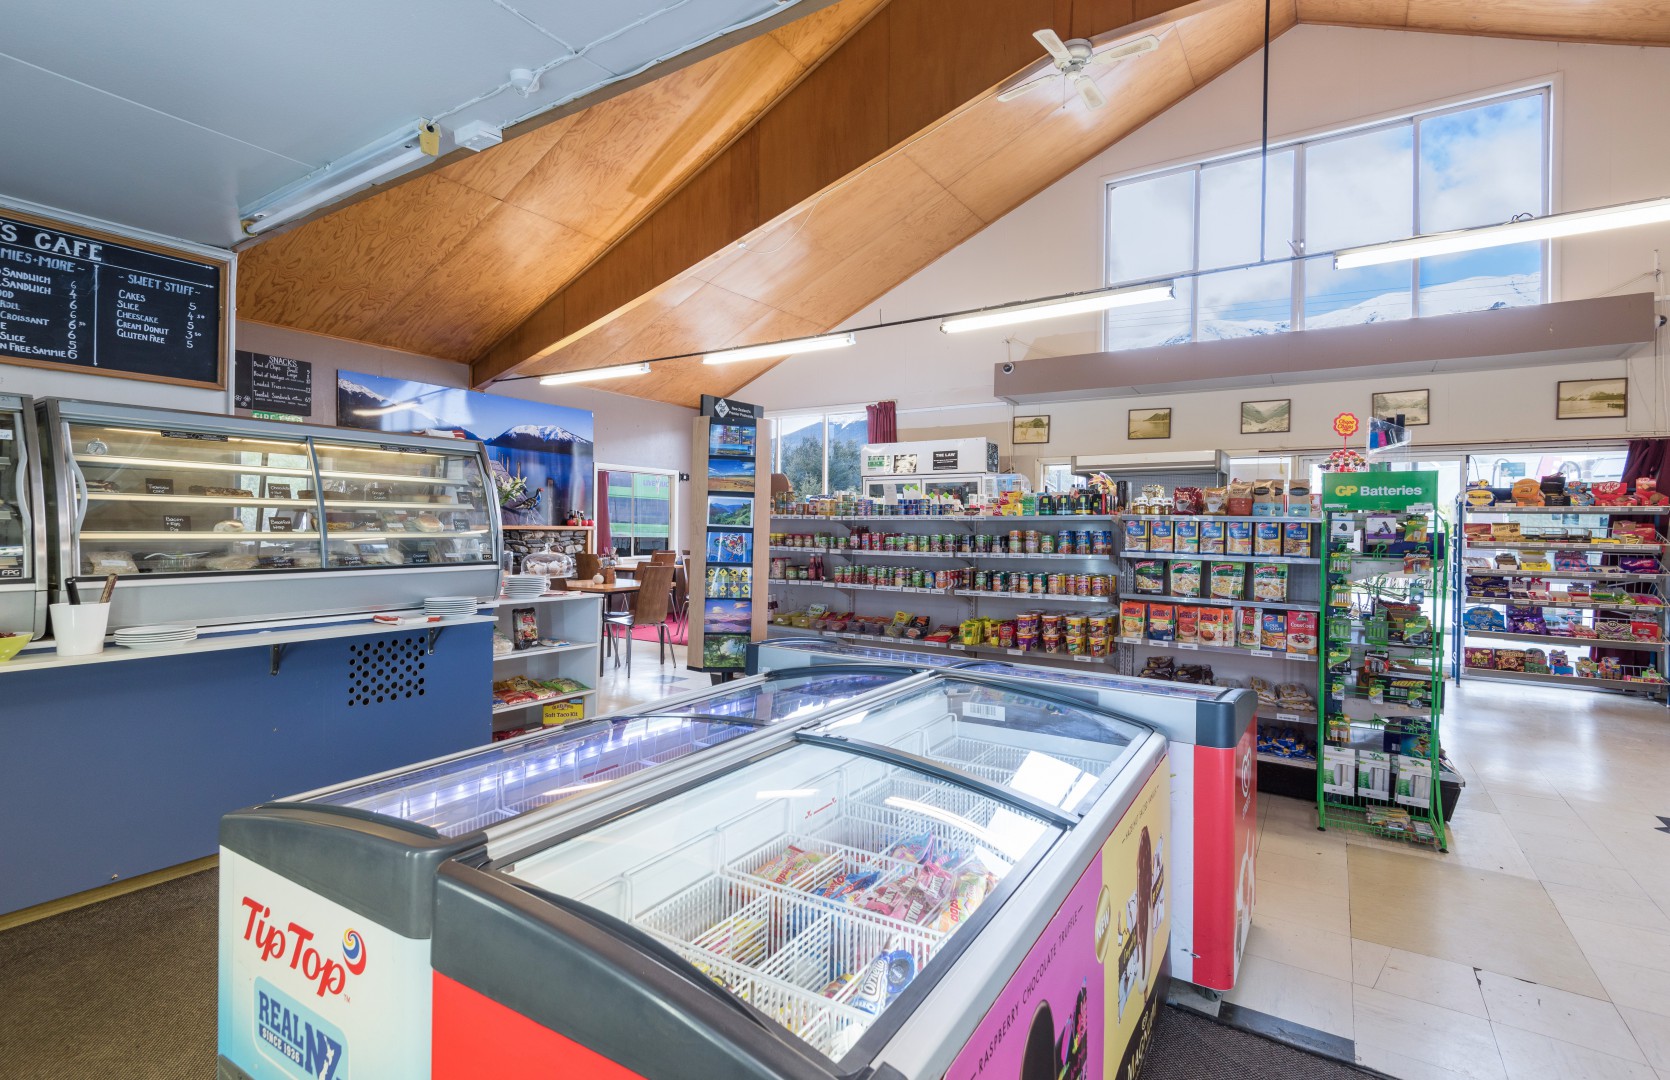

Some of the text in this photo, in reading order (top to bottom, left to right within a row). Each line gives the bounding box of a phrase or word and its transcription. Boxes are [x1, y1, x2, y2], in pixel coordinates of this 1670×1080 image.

[0, 222, 102, 261] S CAFE
[2, 267, 77, 289] SANDWICH 6
[127, 274, 194, 296] SWEET STUFF
[1, 278, 77, 299] SANDWICH 4
[69, 300, 77, 310] 6
[117, 299, 139, 311] SLICE
[187, 311, 194, 321] 4
[118, 289, 197, 311] CAKES 5
[0, 310, 50, 326] CROISSANT
[68, 320, 77, 330] 6
[69, 310, 77, 319] 6
[67, 330, 76, 340] 6
[116, 319, 141, 331] CREAM
[143, 324, 170, 335] DONUT
[185, 330, 193, 339] 3
[186, 321, 194, 330] 5
[0, 331, 77, 350] SLICE 5
[116, 328, 194, 349] GLUTEN FREE 5
[9, 342, 31, 354] FREE
[32, 346, 66, 358] SAMMIE
[67, 349, 77, 359] 6
[269, 356, 298, 367] SNACKS
[271, 392, 290, 401] Sandwich
[1335, 485, 1422, 497] GP Batteries
[1, 569, 20, 577] FPG
[1097, 906, 1110, 939] NEW
[978, 912, 1078, 1074] RASPBERRY CHOCOLATE TRUFFLE
[259, 990, 303, 1050] REAL
[262, 1027, 300, 1063] SINCE 1936
[305, 1021, 342, 1080] NZ
